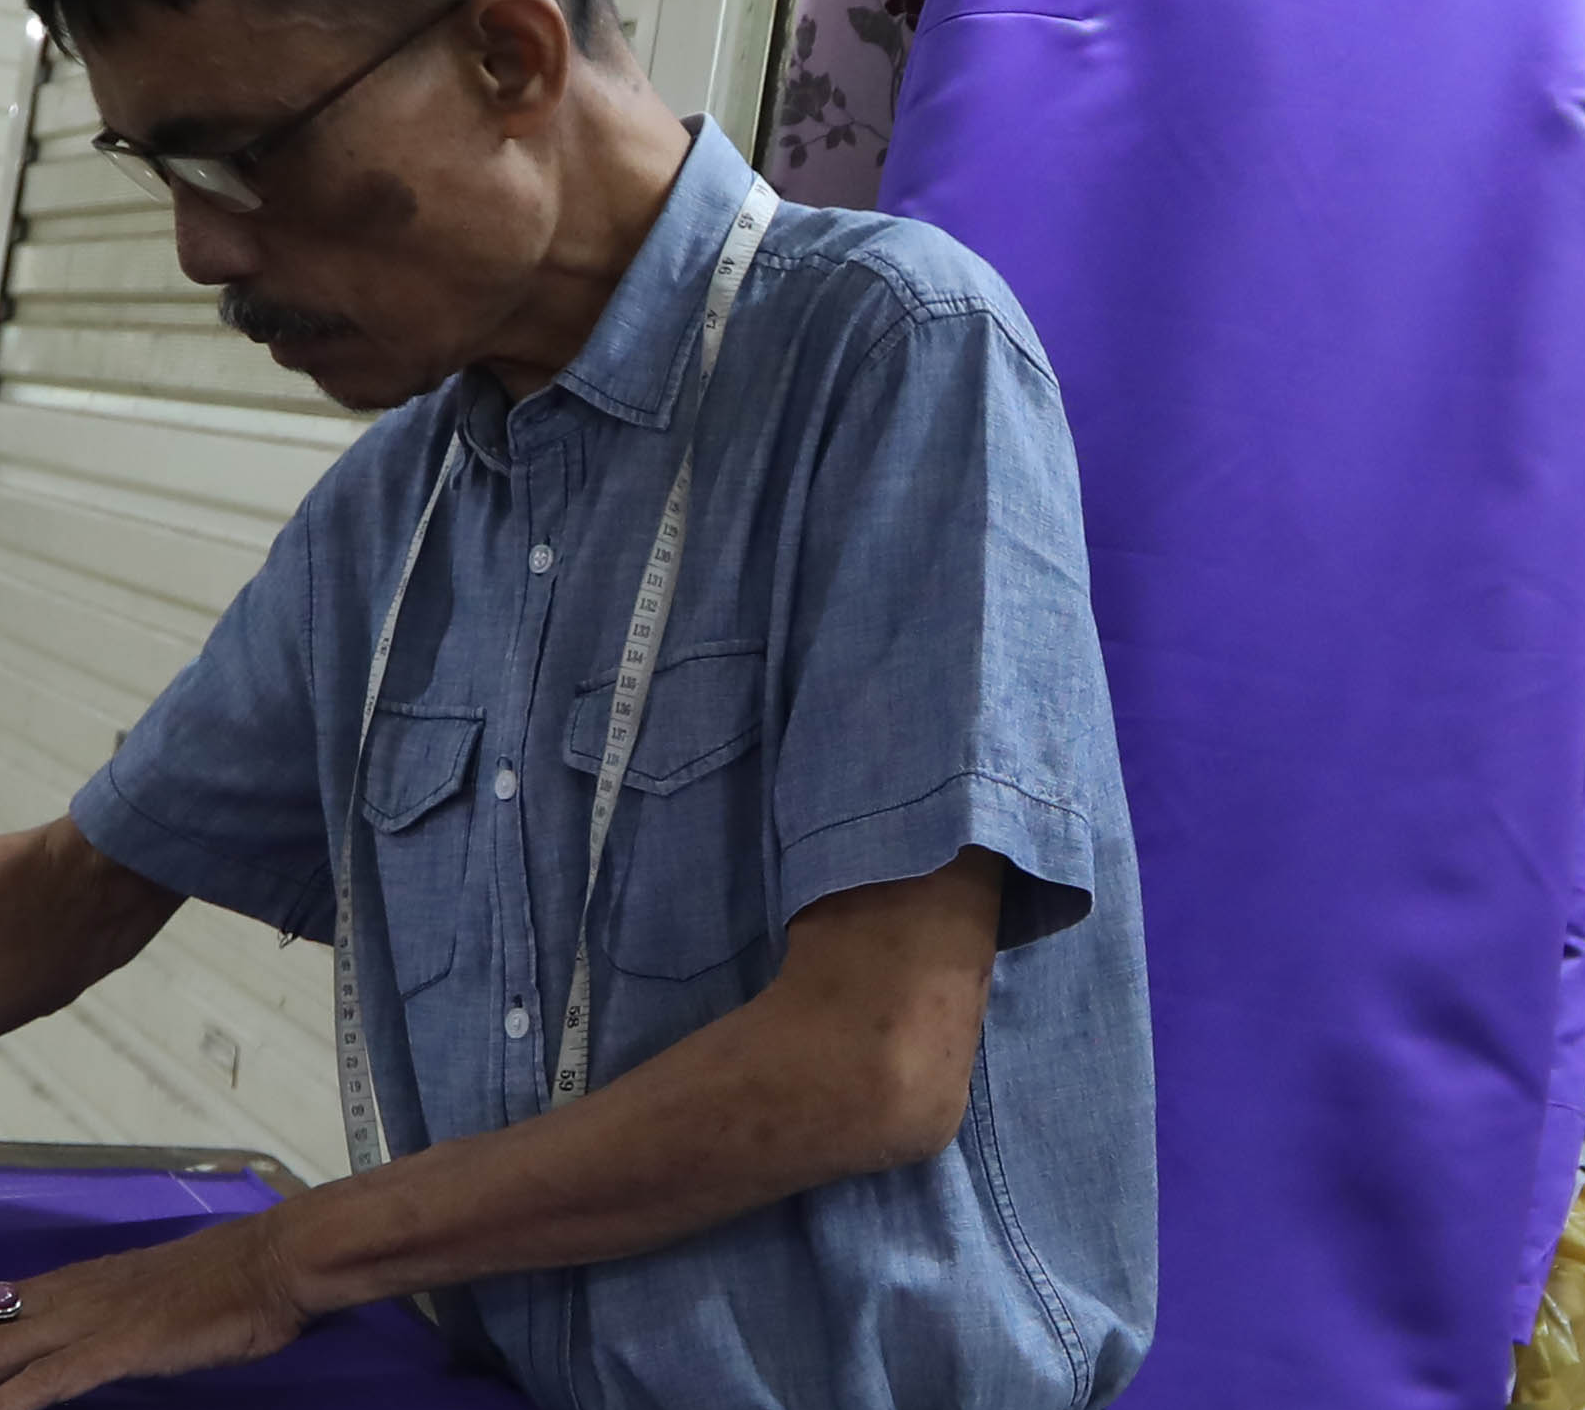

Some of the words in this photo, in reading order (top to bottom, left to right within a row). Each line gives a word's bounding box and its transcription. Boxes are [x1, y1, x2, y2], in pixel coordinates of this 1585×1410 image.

[737, 212, 754, 230] 45
[718, 257, 735, 275] 46
[566, 1005, 581, 1029] 58
[344, 1032, 357, 1045] 63
[346, 1056, 359, 1069] 62
[349, 1080, 362, 1094] 61
[558, 1069, 576, 1092] 59
[351, 1104, 365, 1117] 60
